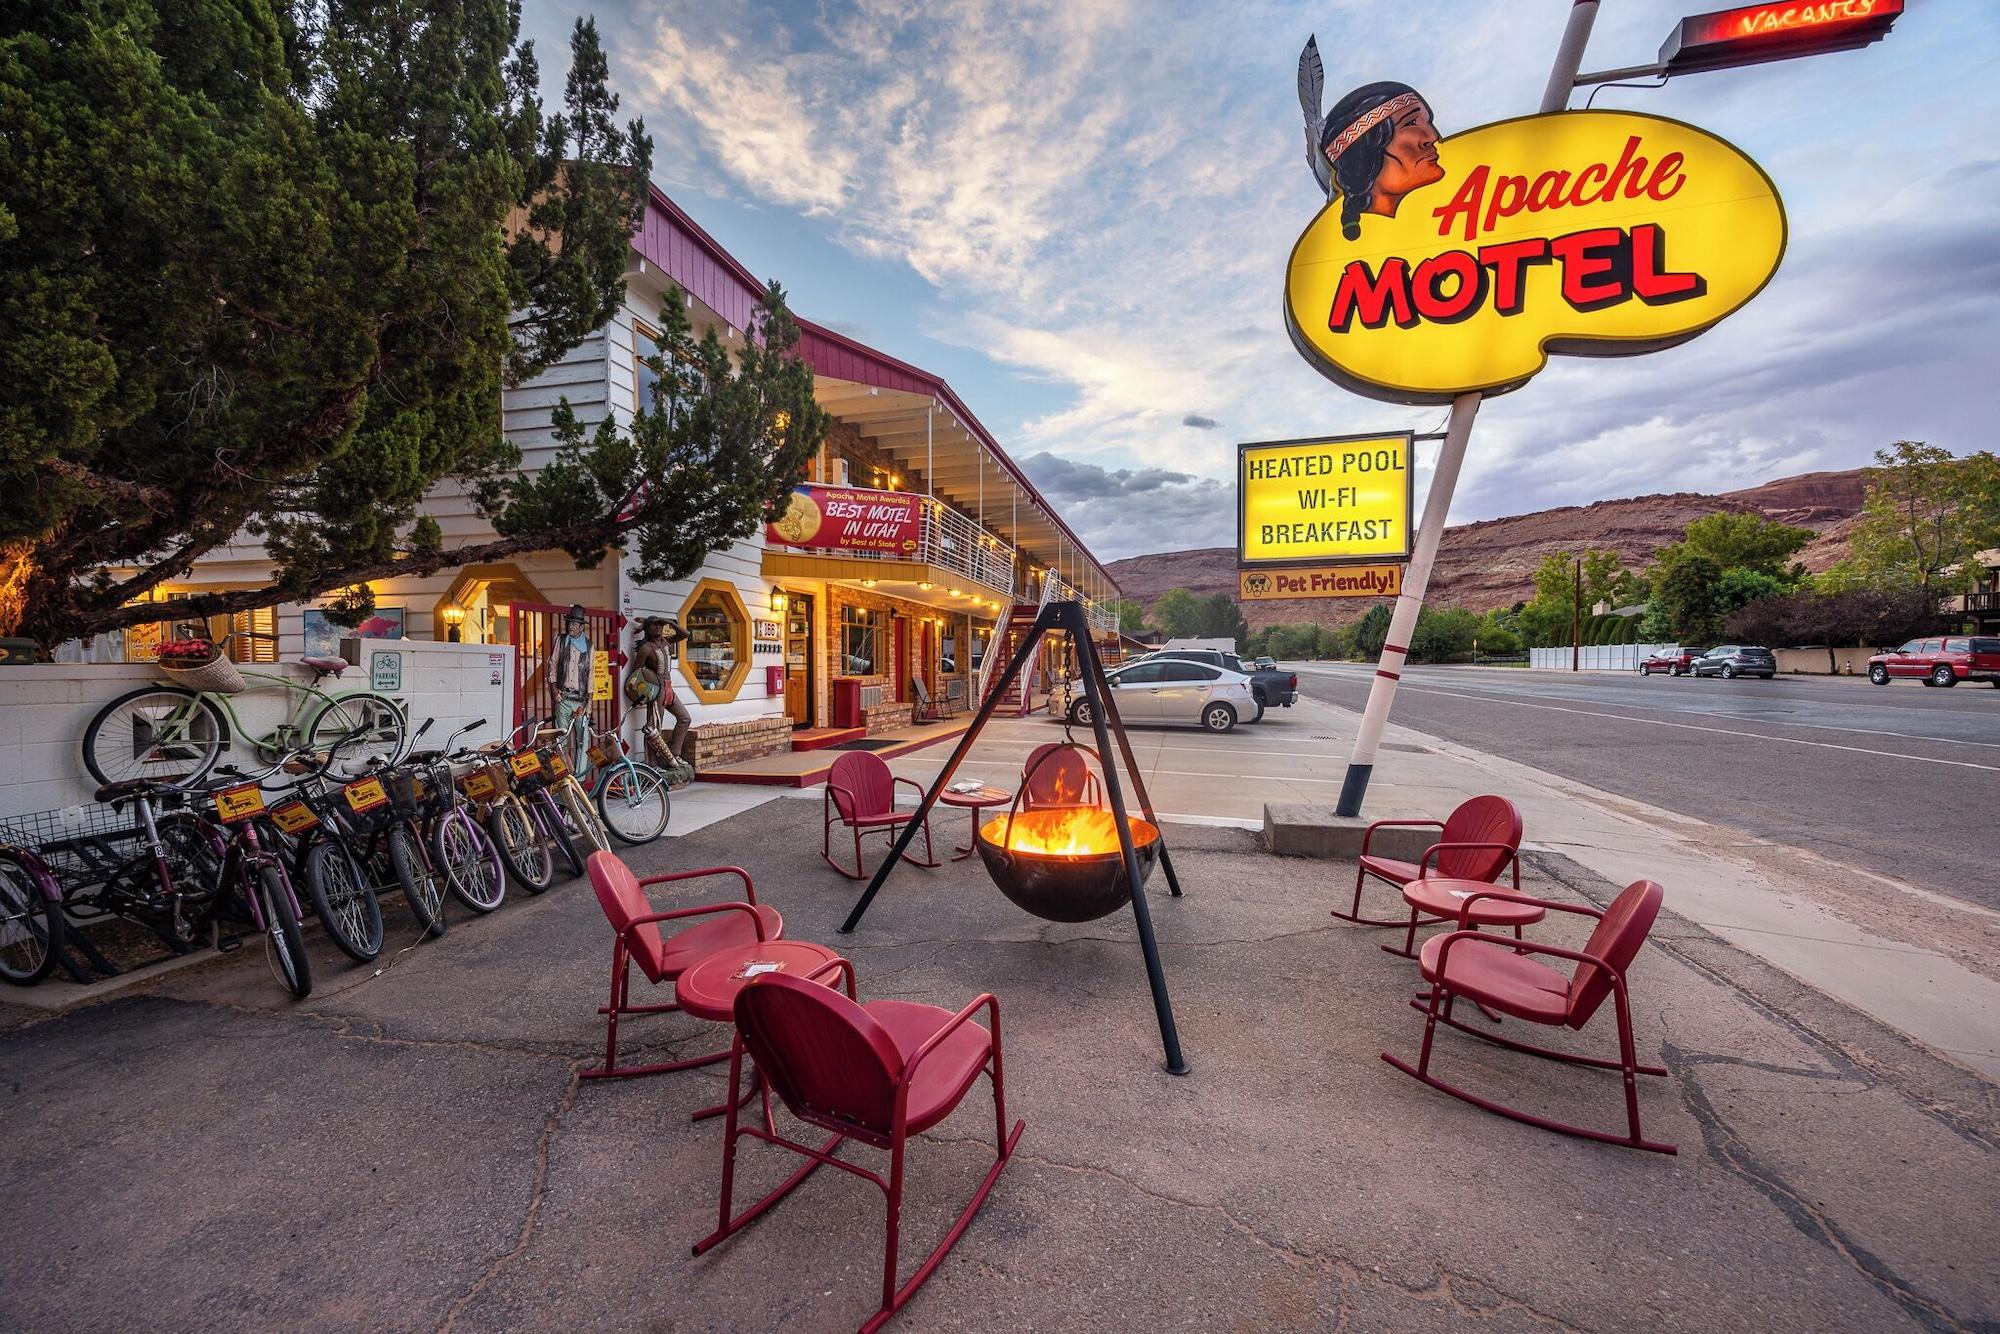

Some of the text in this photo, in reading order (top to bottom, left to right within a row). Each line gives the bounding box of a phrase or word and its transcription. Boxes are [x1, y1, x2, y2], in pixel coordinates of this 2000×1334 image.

[1742, 0, 1876, 33] VACANCY
[1432, 135, 1687, 242] Apache
[1328, 222, 1707, 334] MOTEL
[1249, 450, 1405, 480] HEATED POOL
[826, 491, 911, 505] Apache Motel Awarded
[1298, 487, 1357, 510] WI-FI
[826, 501, 912, 523] BEST MOTEL
[843, 520, 900, 538] IN UTAH
[1261, 519, 1393, 545] BREAKFAST
[840, 537, 850, 546] by
[1276, 571, 1395, 594] Pet Friendly!
[375, 672, 398, 680] PARKING
